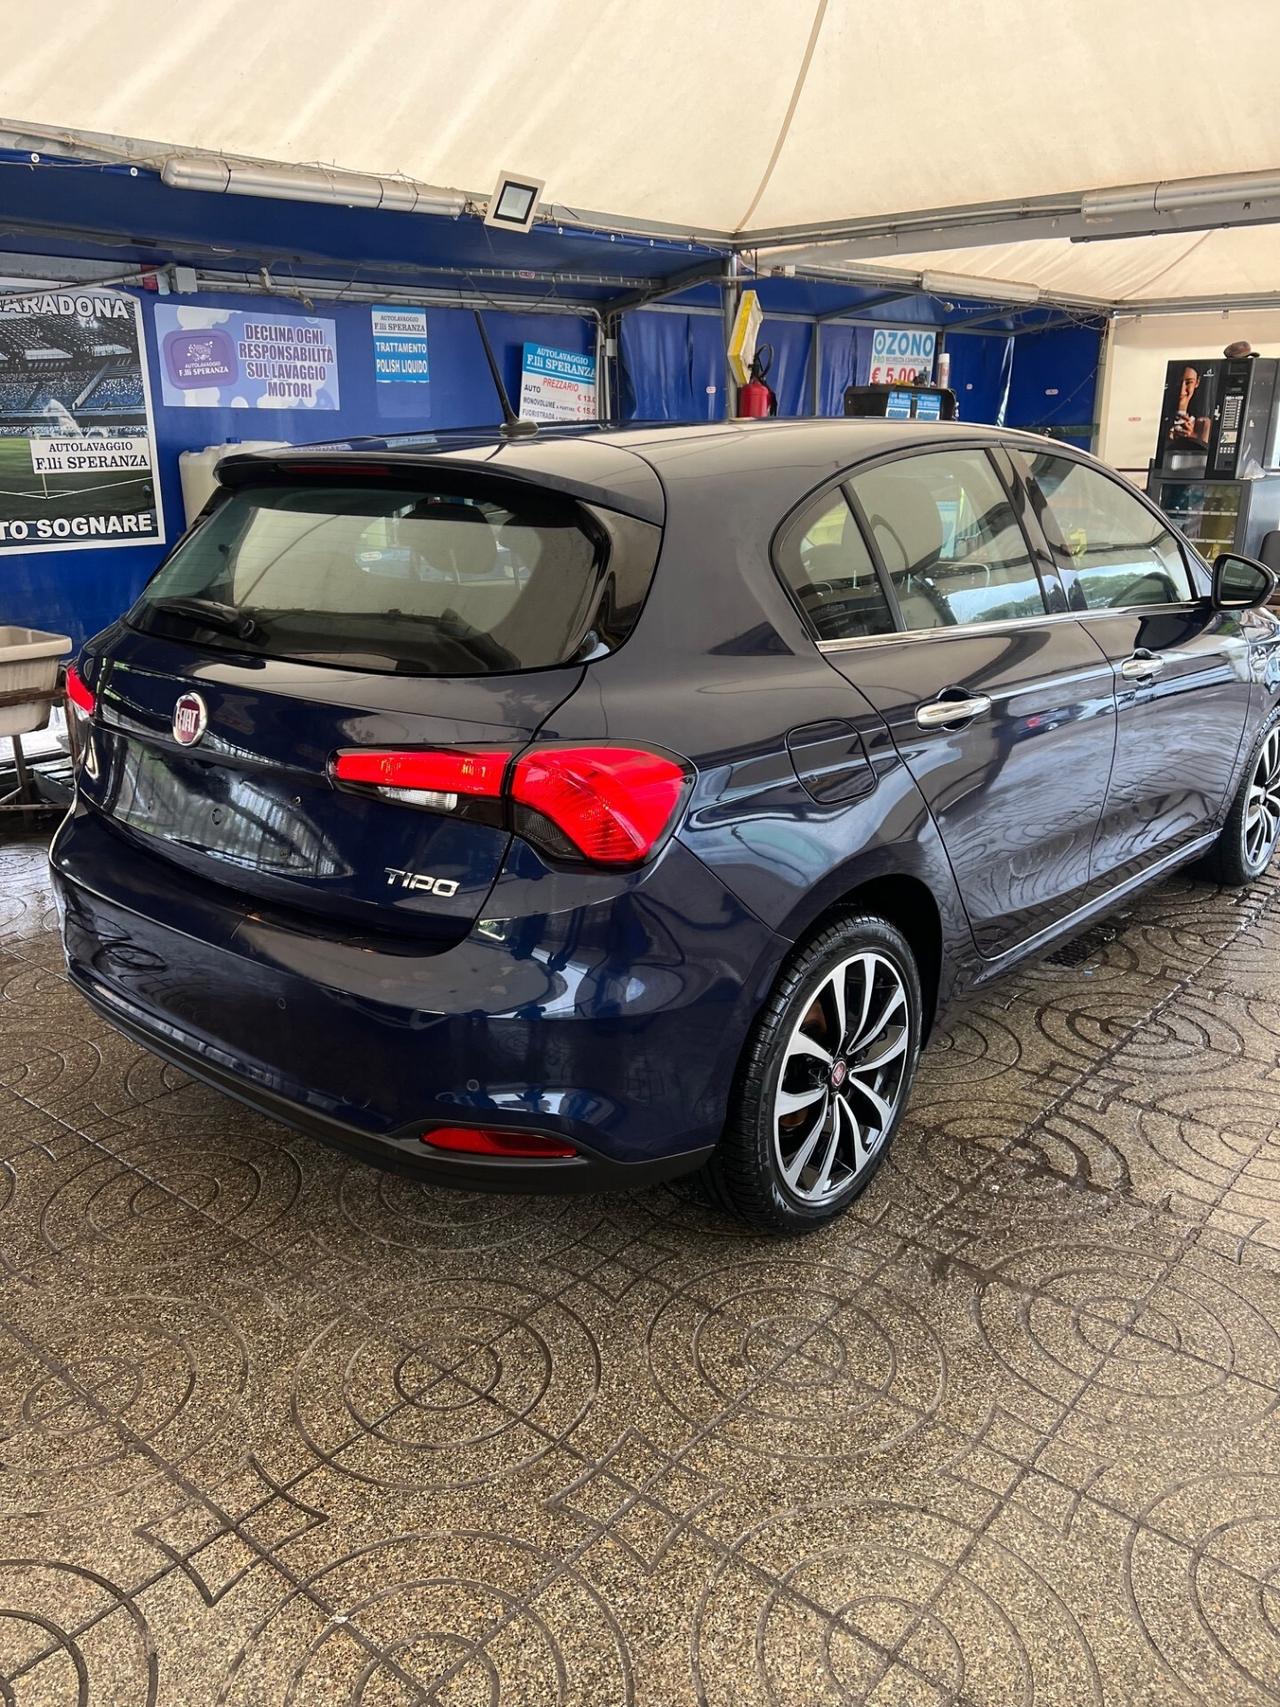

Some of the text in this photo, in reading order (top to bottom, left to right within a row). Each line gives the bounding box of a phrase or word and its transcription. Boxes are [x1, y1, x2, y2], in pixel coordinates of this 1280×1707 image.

[0, 292, 129, 319] ARADONA
[245, 324, 323, 344] DECLINA OGNI
[388, 323, 426, 332] SPERANZA
[375, 342, 427, 353] TRATTAMENTO
[874, 331, 934, 357] OZONO
[239, 343, 334, 363] RESPONSABILITÀ
[527, 354, 543, 368] F.lli
[536, 347, 589, 365] AUTOLAVAGGIO
[193, 366, 229, 375] SPERANZA
[247, 362, 326, 381] SUL LAVAGGIO
[376, 359, 428, 373] POLISH LIQUIDO
[871, 367, 881, 384] €
[267, 381, 312, 398] MOTORI
[524, 384, 541, 393] AUTO
[543, 377, 580, 393] PREZZARIO
[523, 396, 556, 409] MONOVOLUME
[49, 441, 133, 453] AUTOLAVAGGIO
[35, 454, 149, 471] F.lli SPERANZA
[36, 513, 152, 538] SOGNARE
[177, 707, 199, 733] FIAT
[384, 867, 460, 898] TIPO
